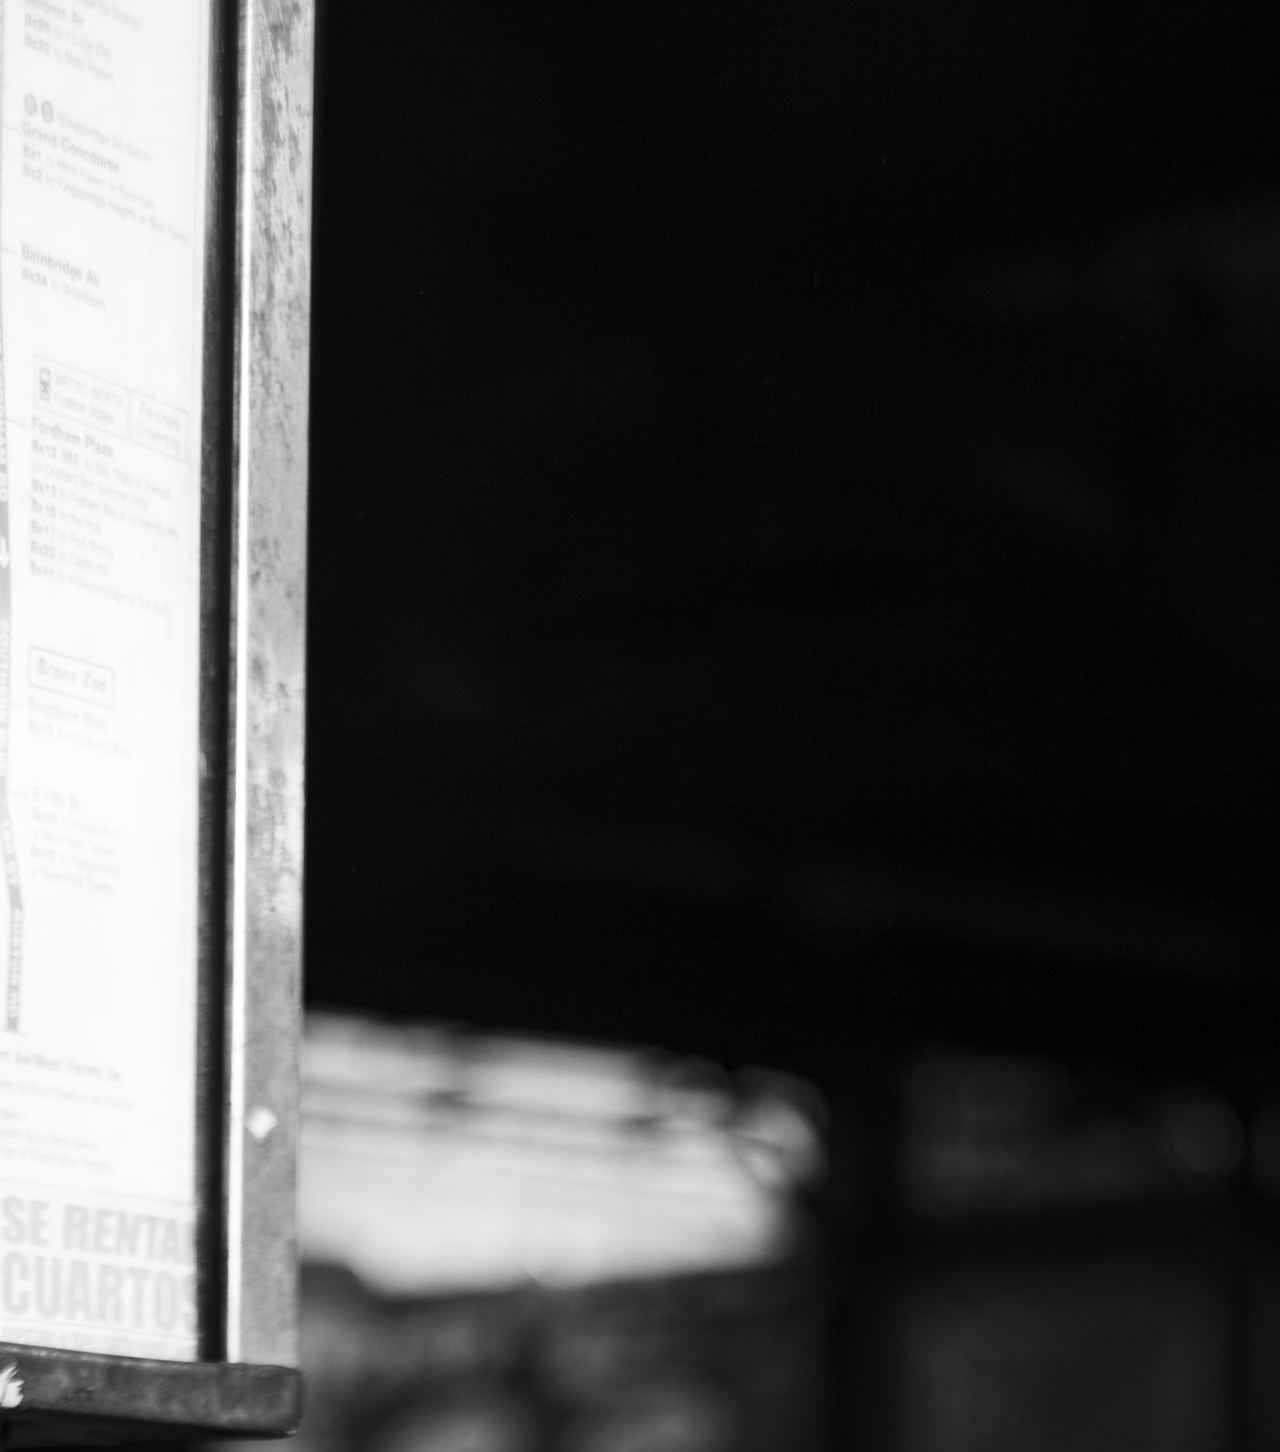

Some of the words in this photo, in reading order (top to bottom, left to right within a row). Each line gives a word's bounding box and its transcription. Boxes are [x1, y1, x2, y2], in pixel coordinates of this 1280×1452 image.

[21, 242, 84, 283] Bainbridge
[0, 1195, 52, 1248] SE
[62, 1203, 189, 1265] RENTA
